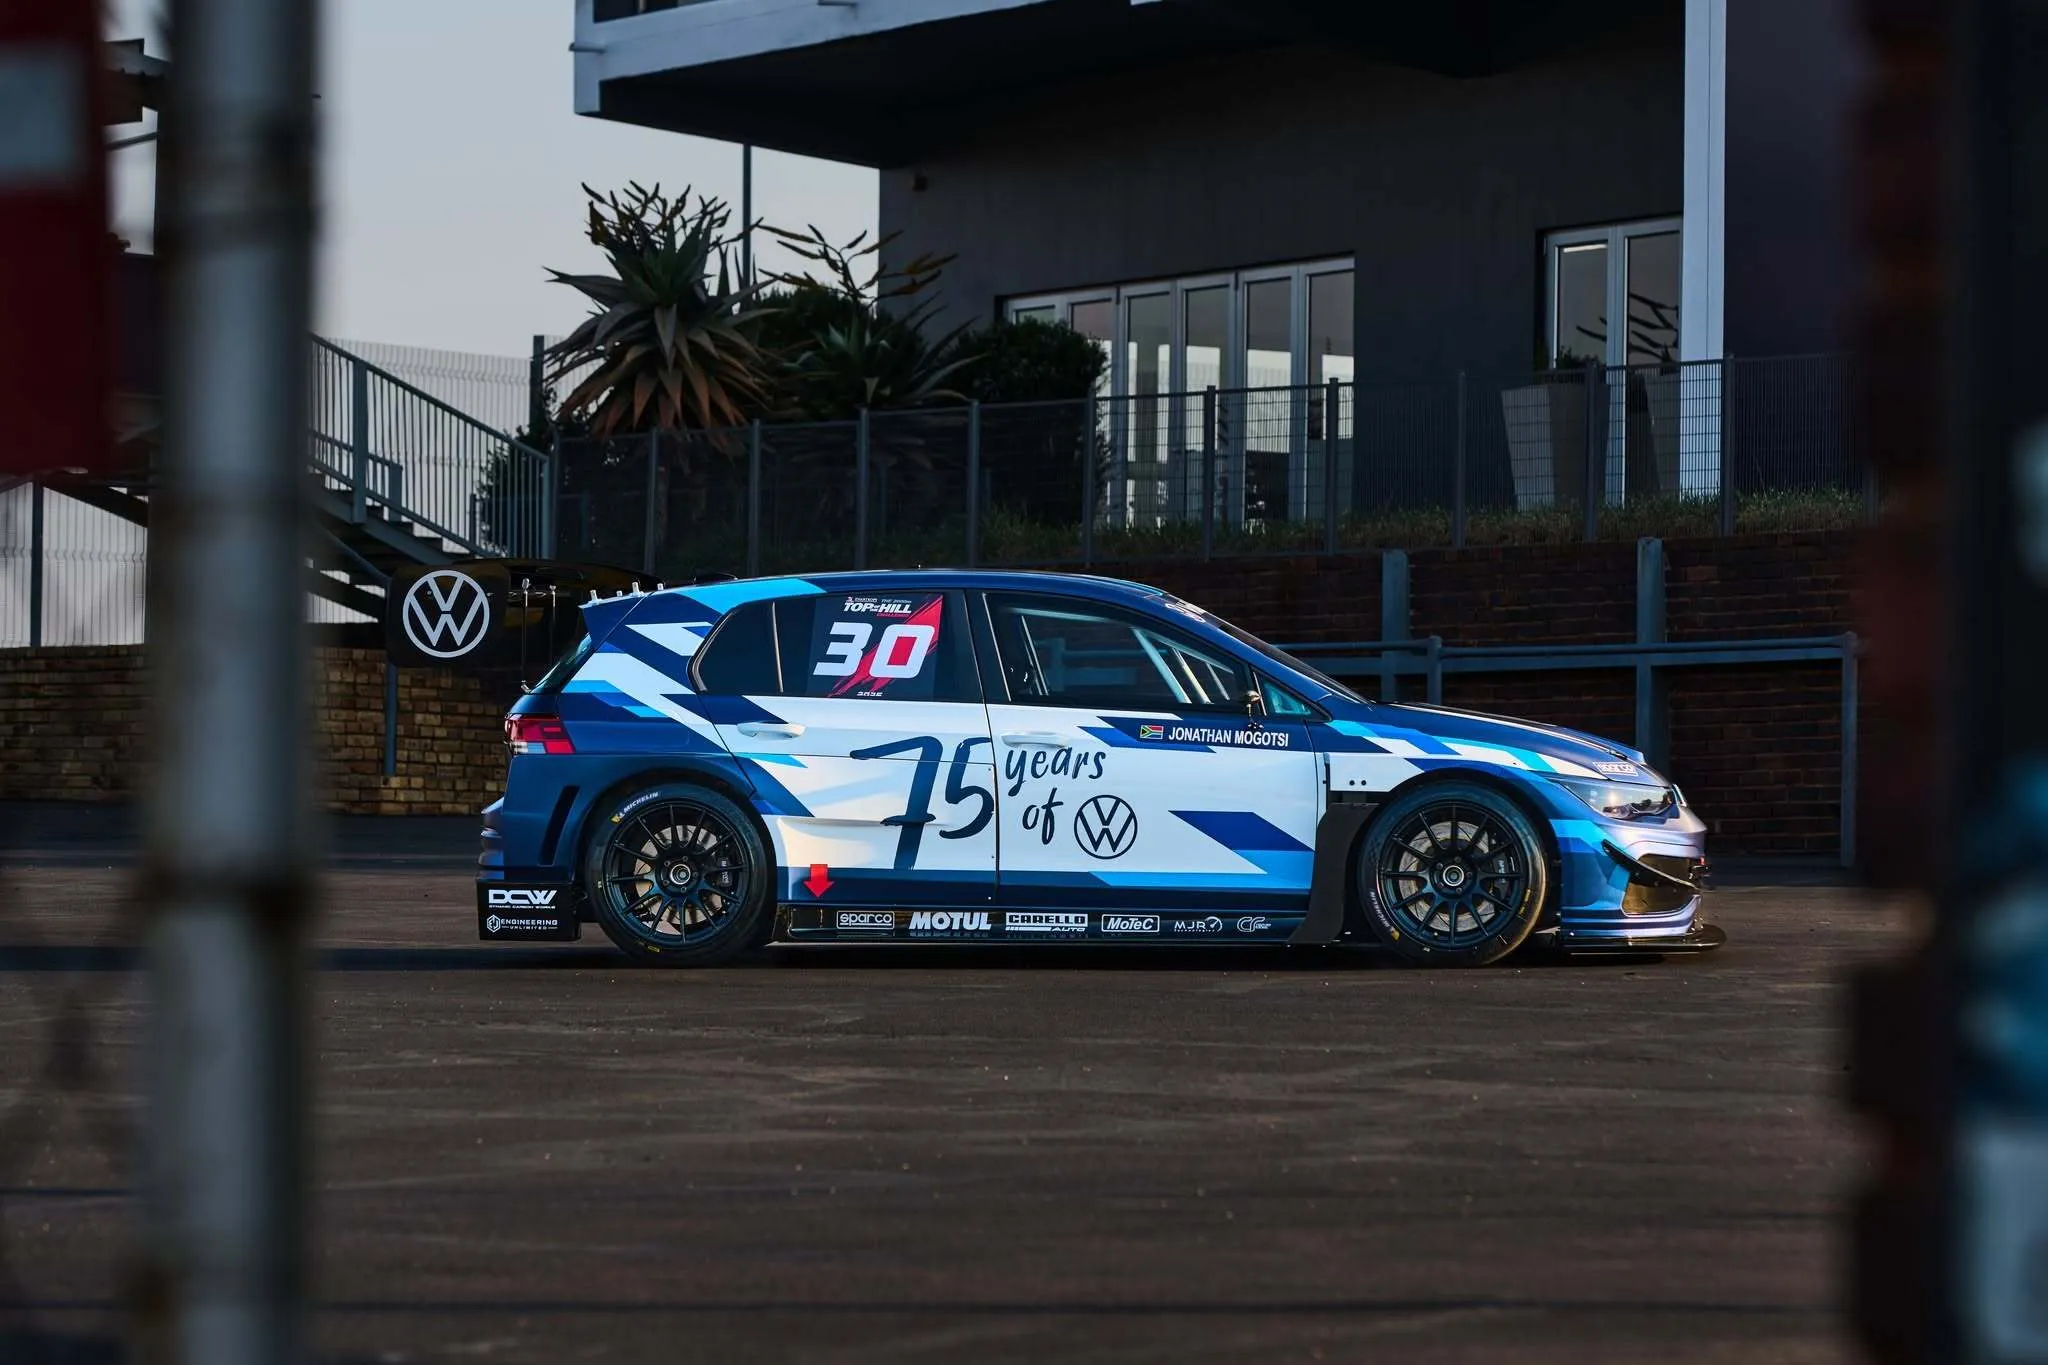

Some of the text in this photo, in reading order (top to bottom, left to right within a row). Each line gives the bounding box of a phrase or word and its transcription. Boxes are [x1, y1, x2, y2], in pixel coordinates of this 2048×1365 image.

[813, 621, 935, 679] 30
[1169, 727, 1289, 747] JONATHAN MOGOTSI
[850, 736, 1106, 870] 75 years
[1022, 787, 1064, 845] of
[488, 889, 557, 905] DCW
[839, 912, 892, 926] sparco
[908, 911, 992, 930] MOTUL
[1008, 914, 1086, 925] CARELLO
[1106, 917, 1155, 930] MoTeC
[1174, 920, 1206, 930] MJR
